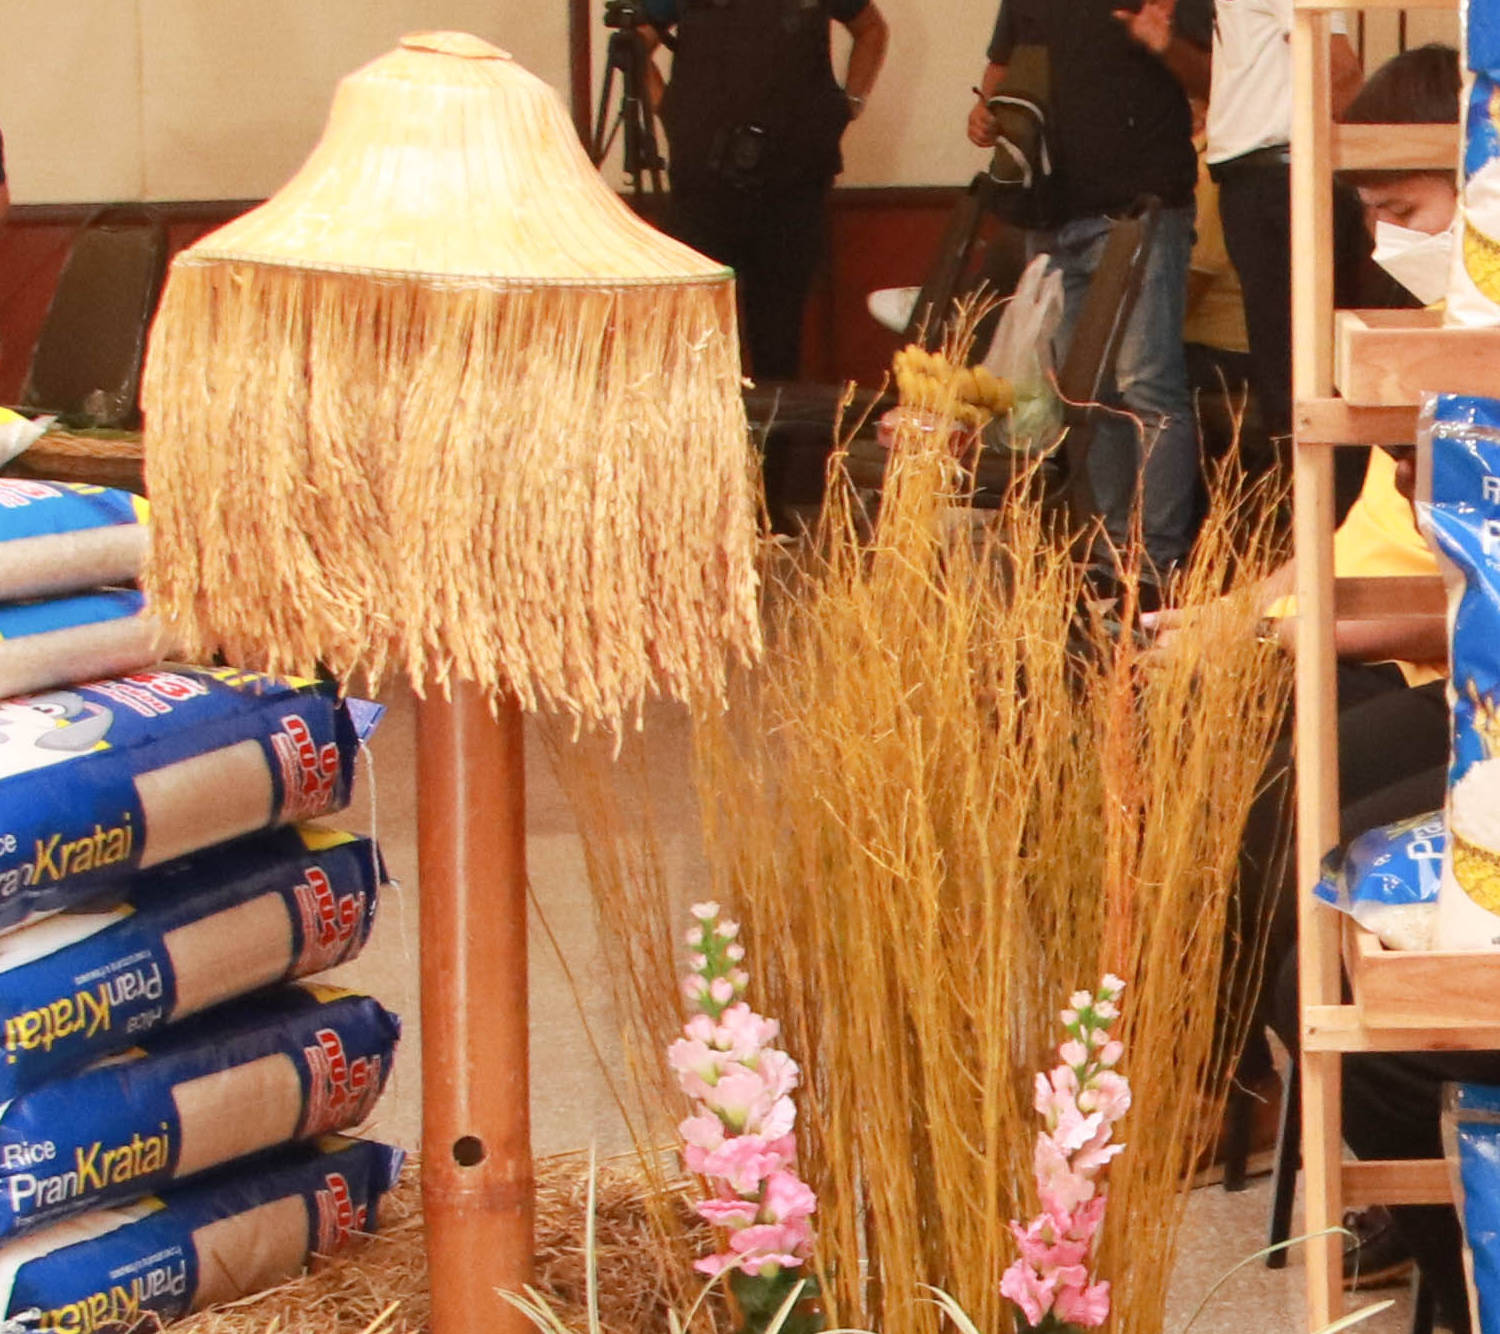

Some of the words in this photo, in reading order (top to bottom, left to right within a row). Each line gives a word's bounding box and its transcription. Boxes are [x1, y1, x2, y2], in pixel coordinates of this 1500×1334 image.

[4, 961, 164, 1065] PranKratai
[2, 1139, 56, 1170] Rice
[9, 1122, 169, 1214] PranKratai
